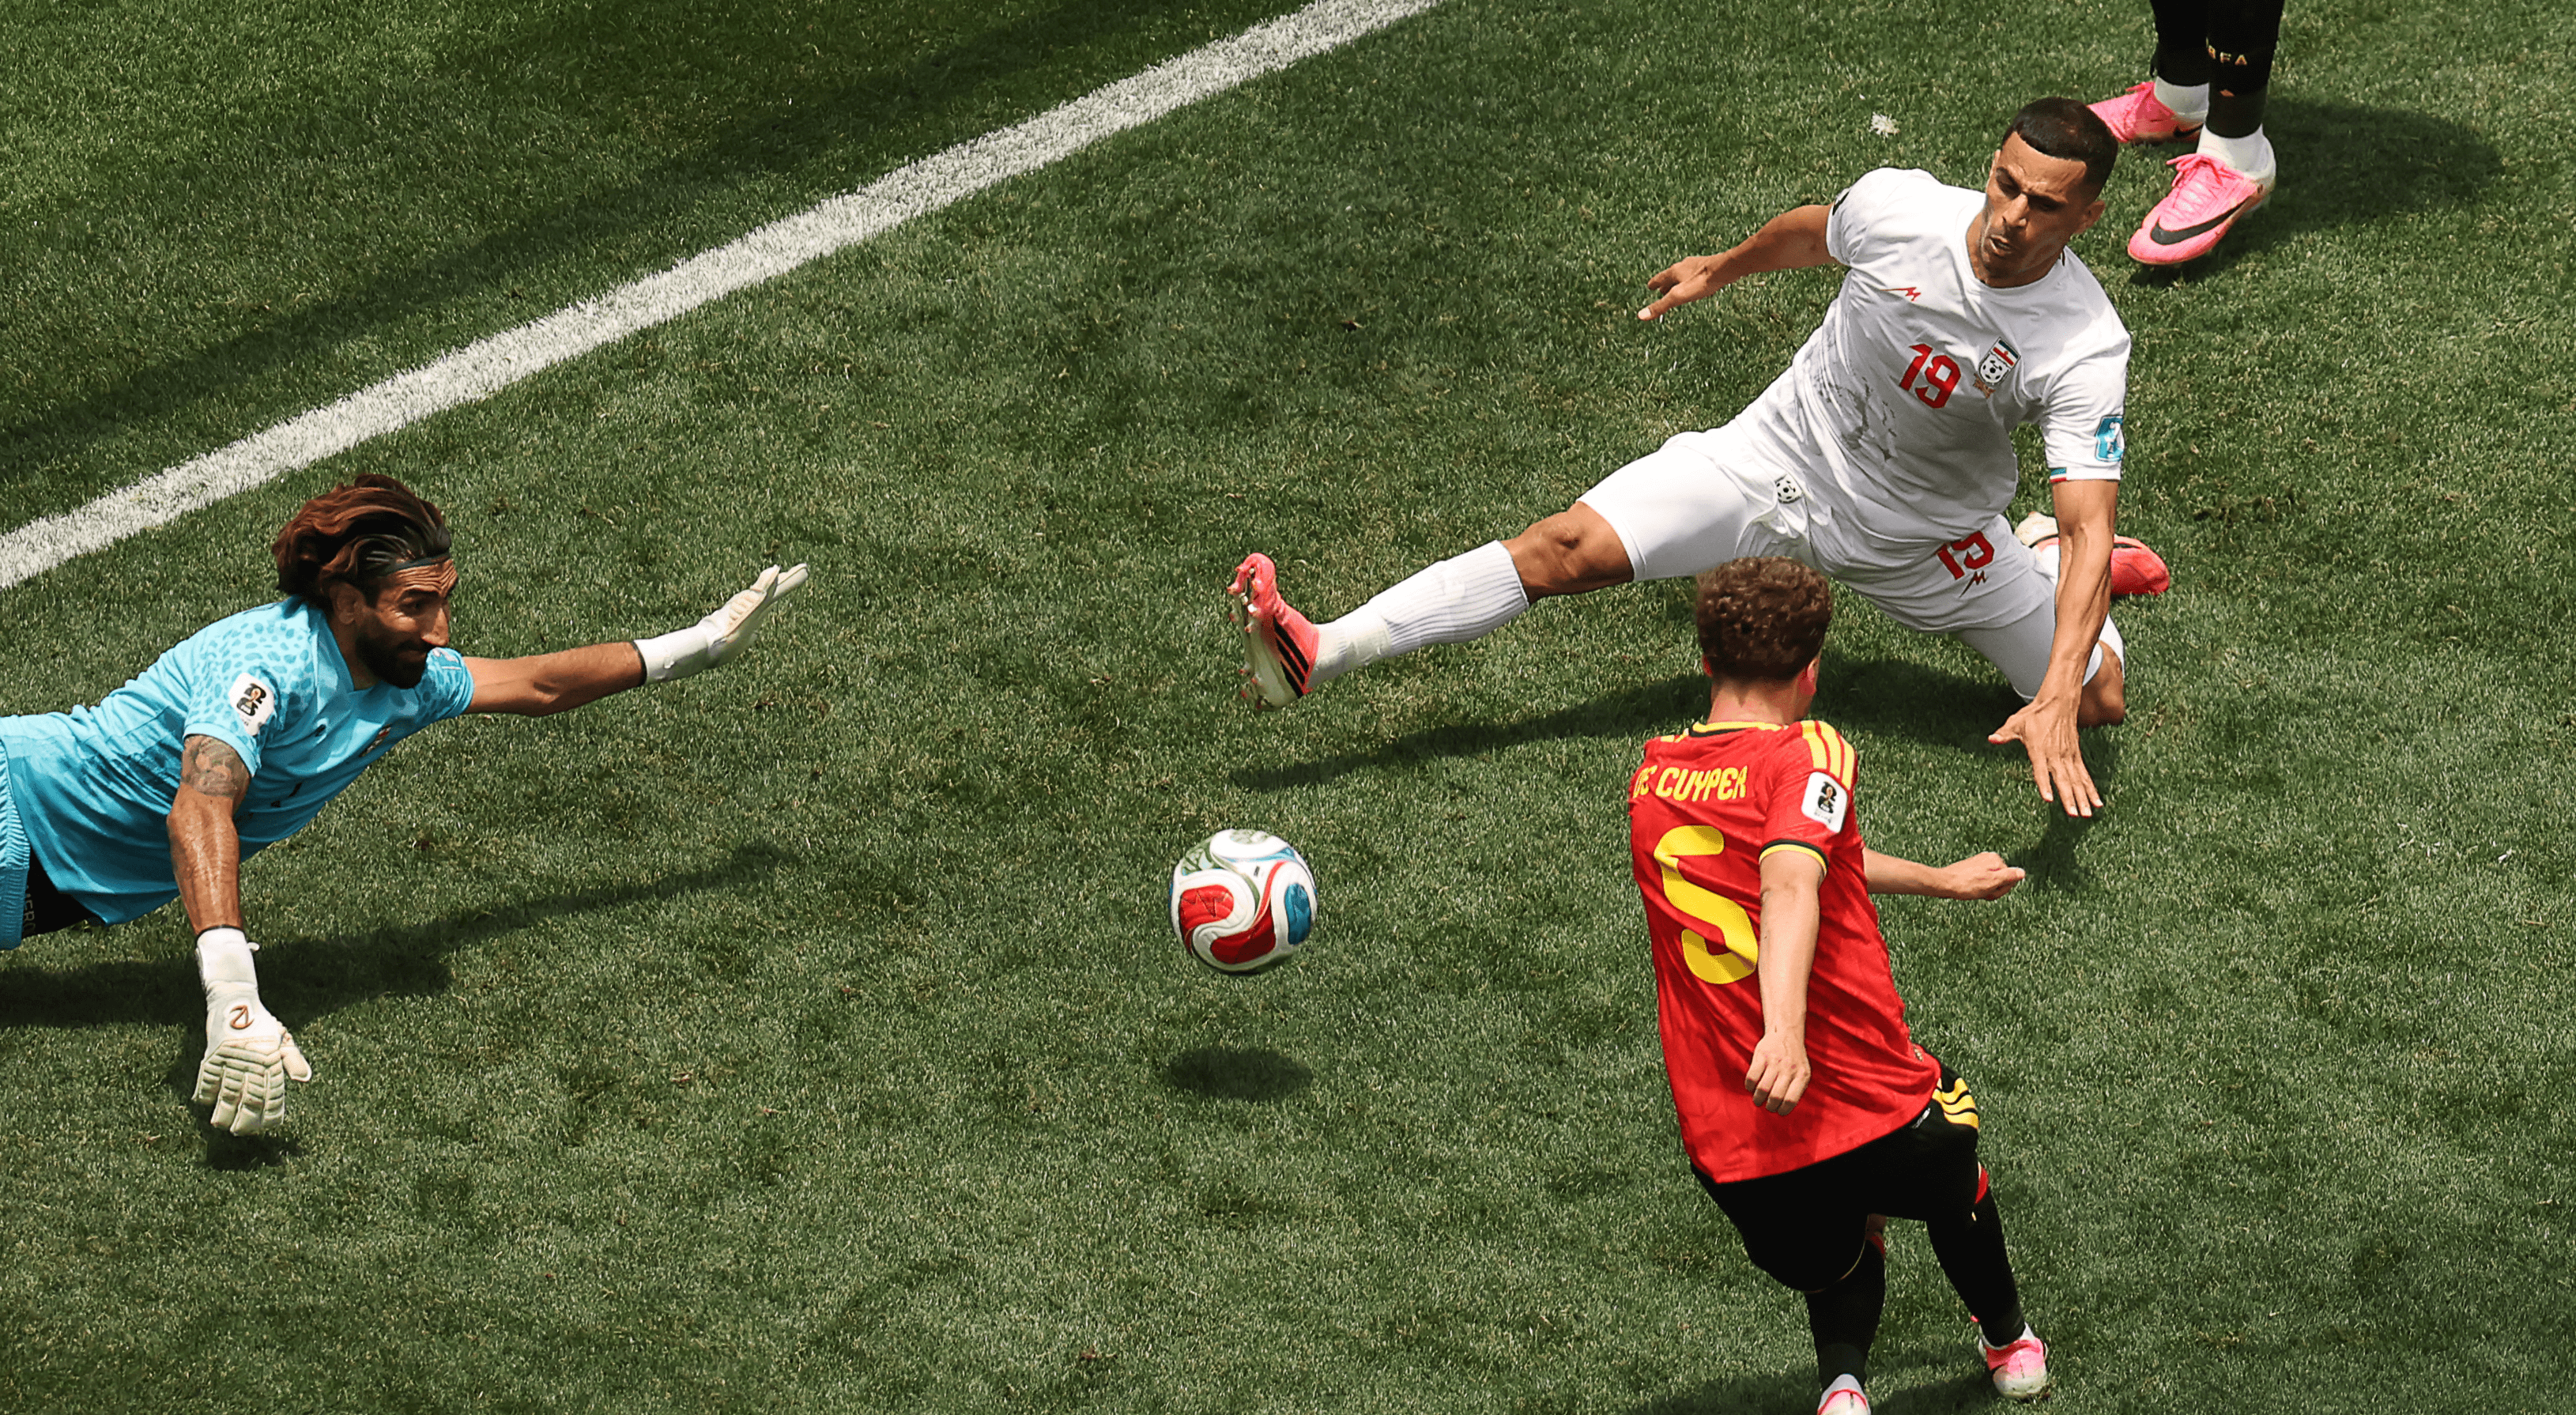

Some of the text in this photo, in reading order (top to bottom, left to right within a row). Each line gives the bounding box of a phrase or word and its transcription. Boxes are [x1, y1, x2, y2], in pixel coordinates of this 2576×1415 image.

[1899, 343, 1962, 409] 19
[1655, 764, 1748, 802] CUYPER
[1653, 824, 1759, 985] 5
